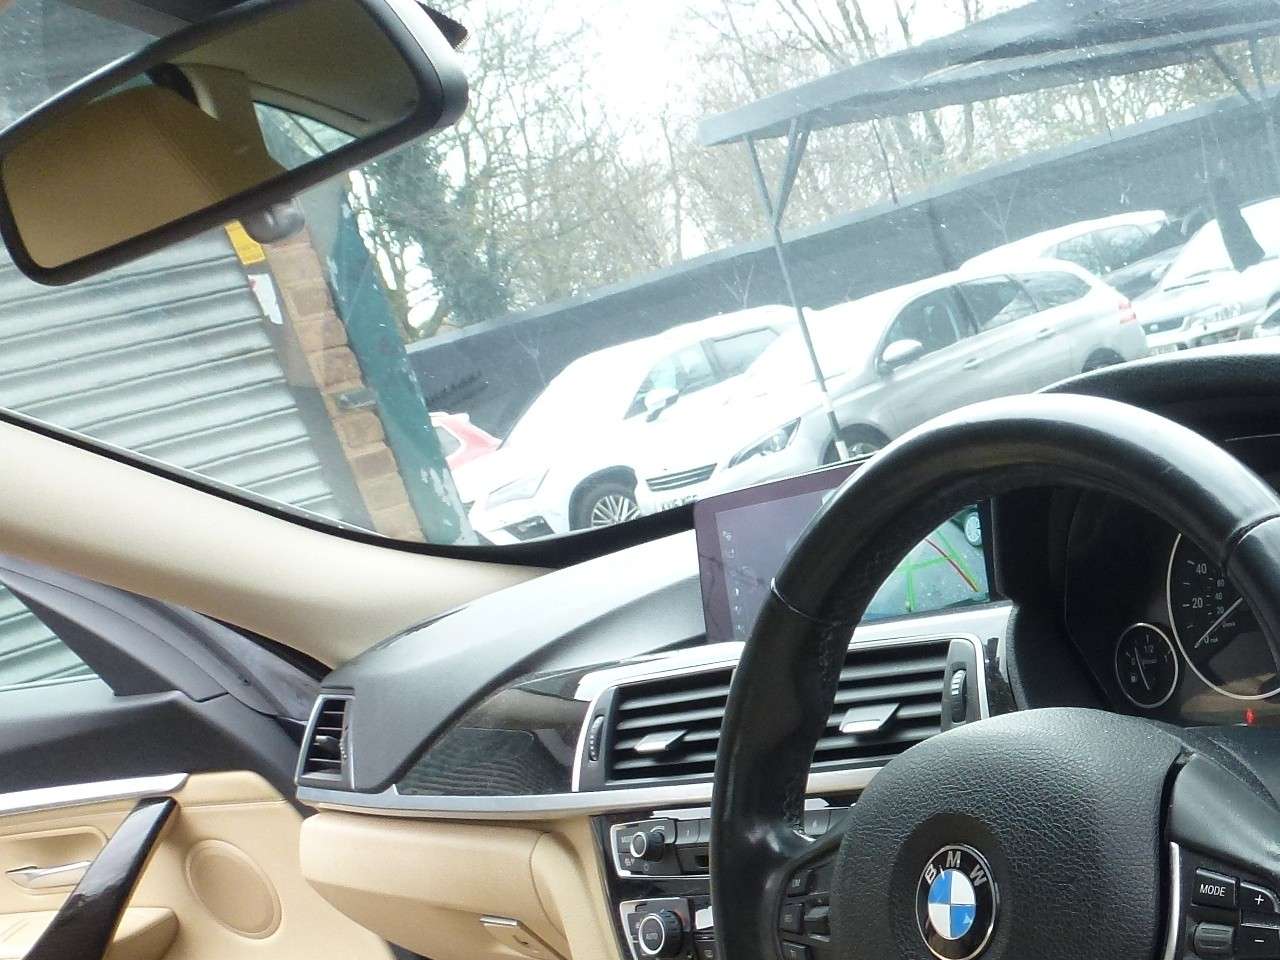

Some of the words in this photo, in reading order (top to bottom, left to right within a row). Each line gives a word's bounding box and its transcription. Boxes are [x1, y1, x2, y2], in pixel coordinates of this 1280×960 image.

[1195, 563, 1207, 575] 40
[1192, 597, 1204, 608] 20
[924, 850, 988, 887] BMW
[1199, 883, 1226, 897] MODE
